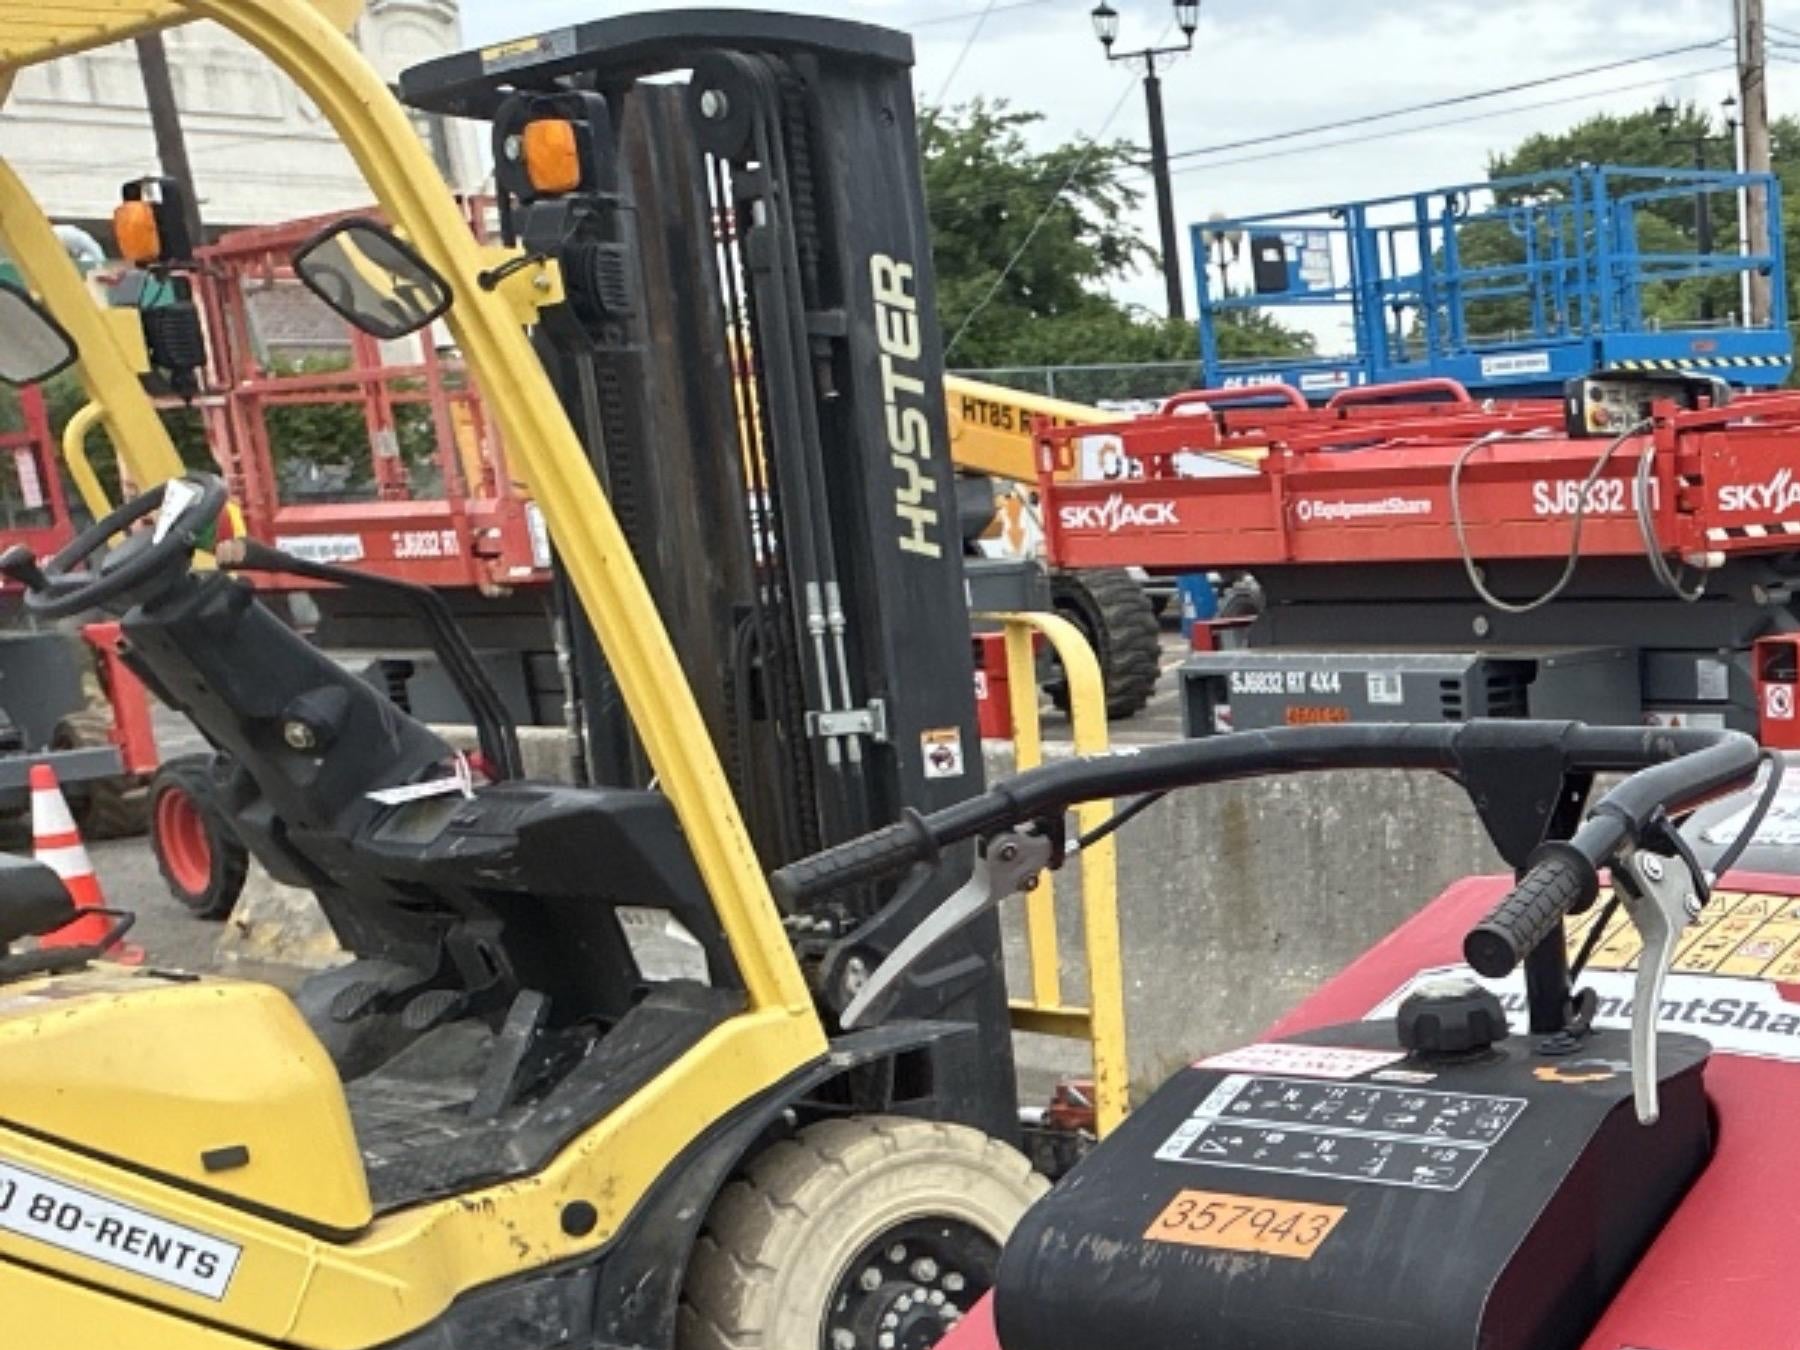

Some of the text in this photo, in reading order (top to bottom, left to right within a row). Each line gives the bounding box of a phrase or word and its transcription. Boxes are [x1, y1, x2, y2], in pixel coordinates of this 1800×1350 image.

[870, 254, 943, 558] HYSTER
[962, 395, 1013, 430] HT85
[1059, 493, 1179, 533] SKYJACK
[27, 1192, 221, 1280] 80-RENTS
[1161, 1200, 1331, 1246] 357943
